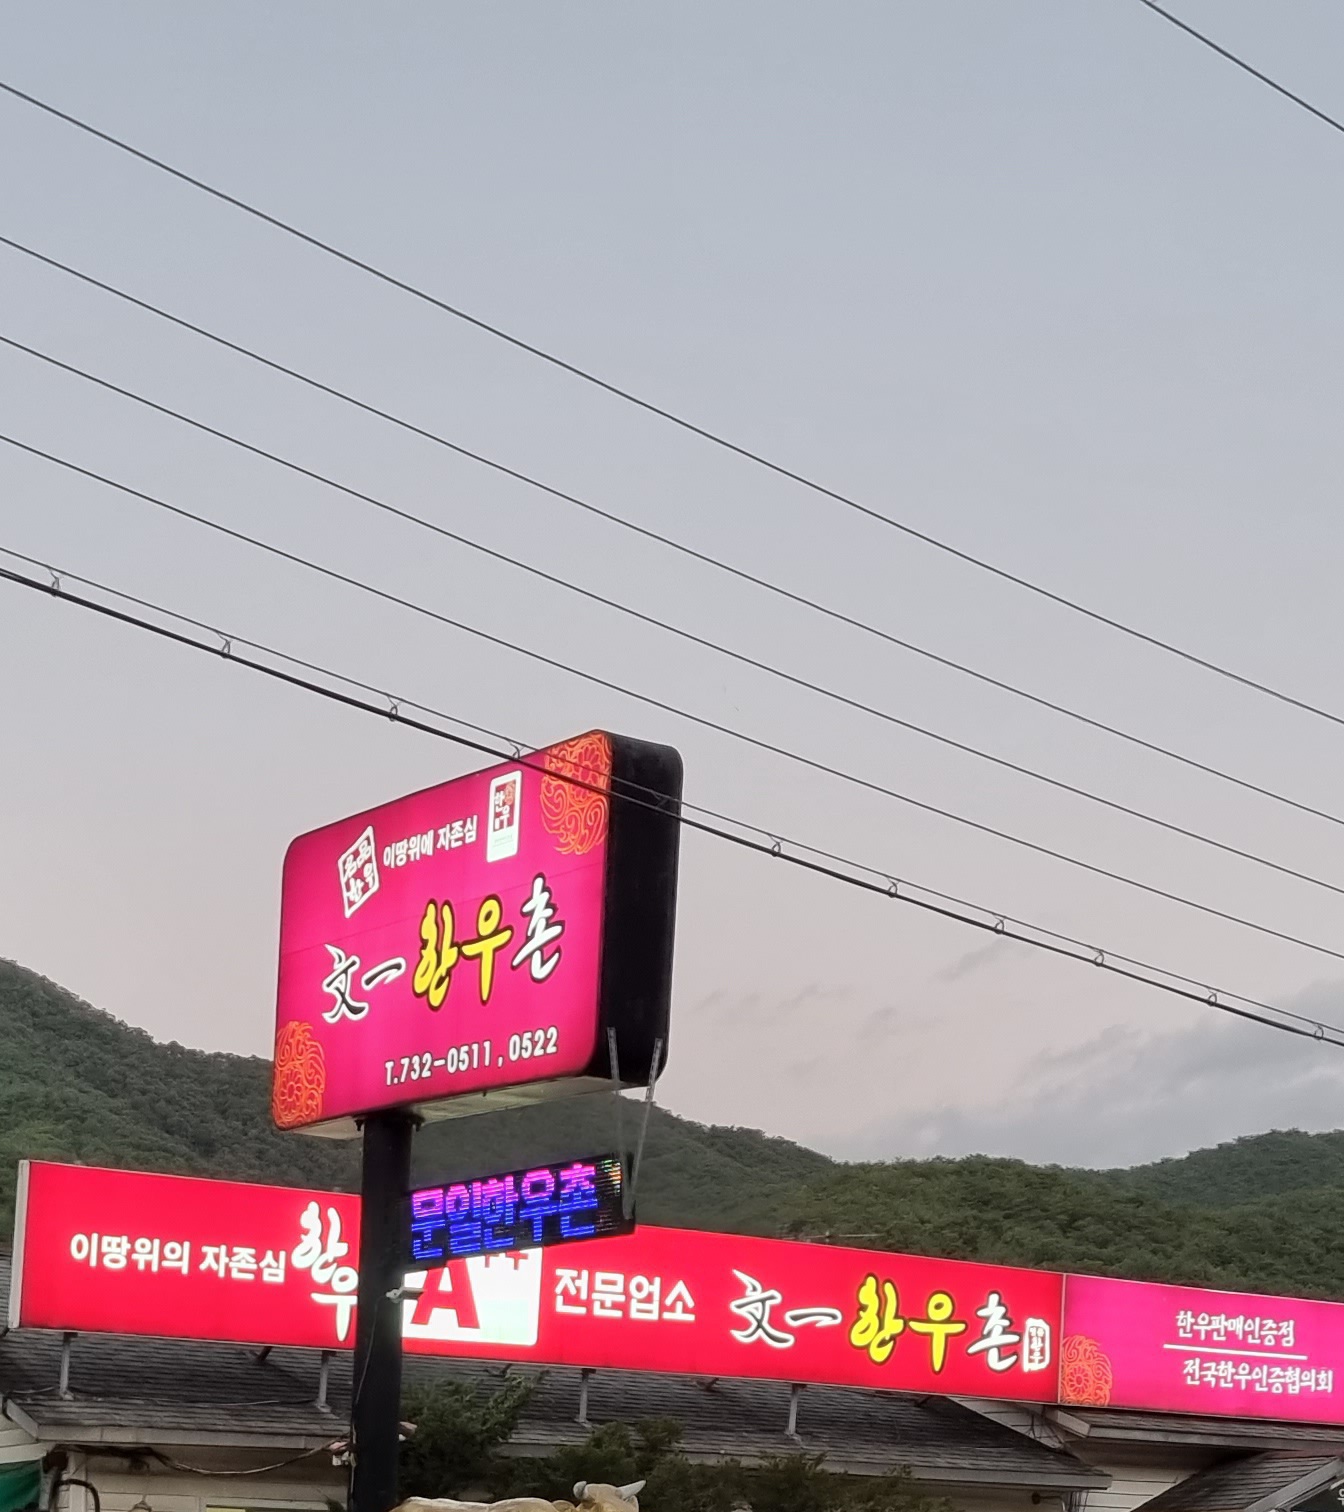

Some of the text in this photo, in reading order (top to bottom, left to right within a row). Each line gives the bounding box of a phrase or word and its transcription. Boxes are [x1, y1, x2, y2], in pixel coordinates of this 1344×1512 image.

[383, 814, 479, 868] 이땅위에 자존심
[509, 1026, 558, 1062] 0522
[411, 1163, 598, 1260] 문일한우촌
[70, 1232, 286, 1283] 이땅위의 자존심
[555, 1268, 696, 1322] 전문업소
[1176, 1311, 1295, 1347] 한우판매인증점
[1183, 1358, 1334, 1394] 전국한우인증협의회
